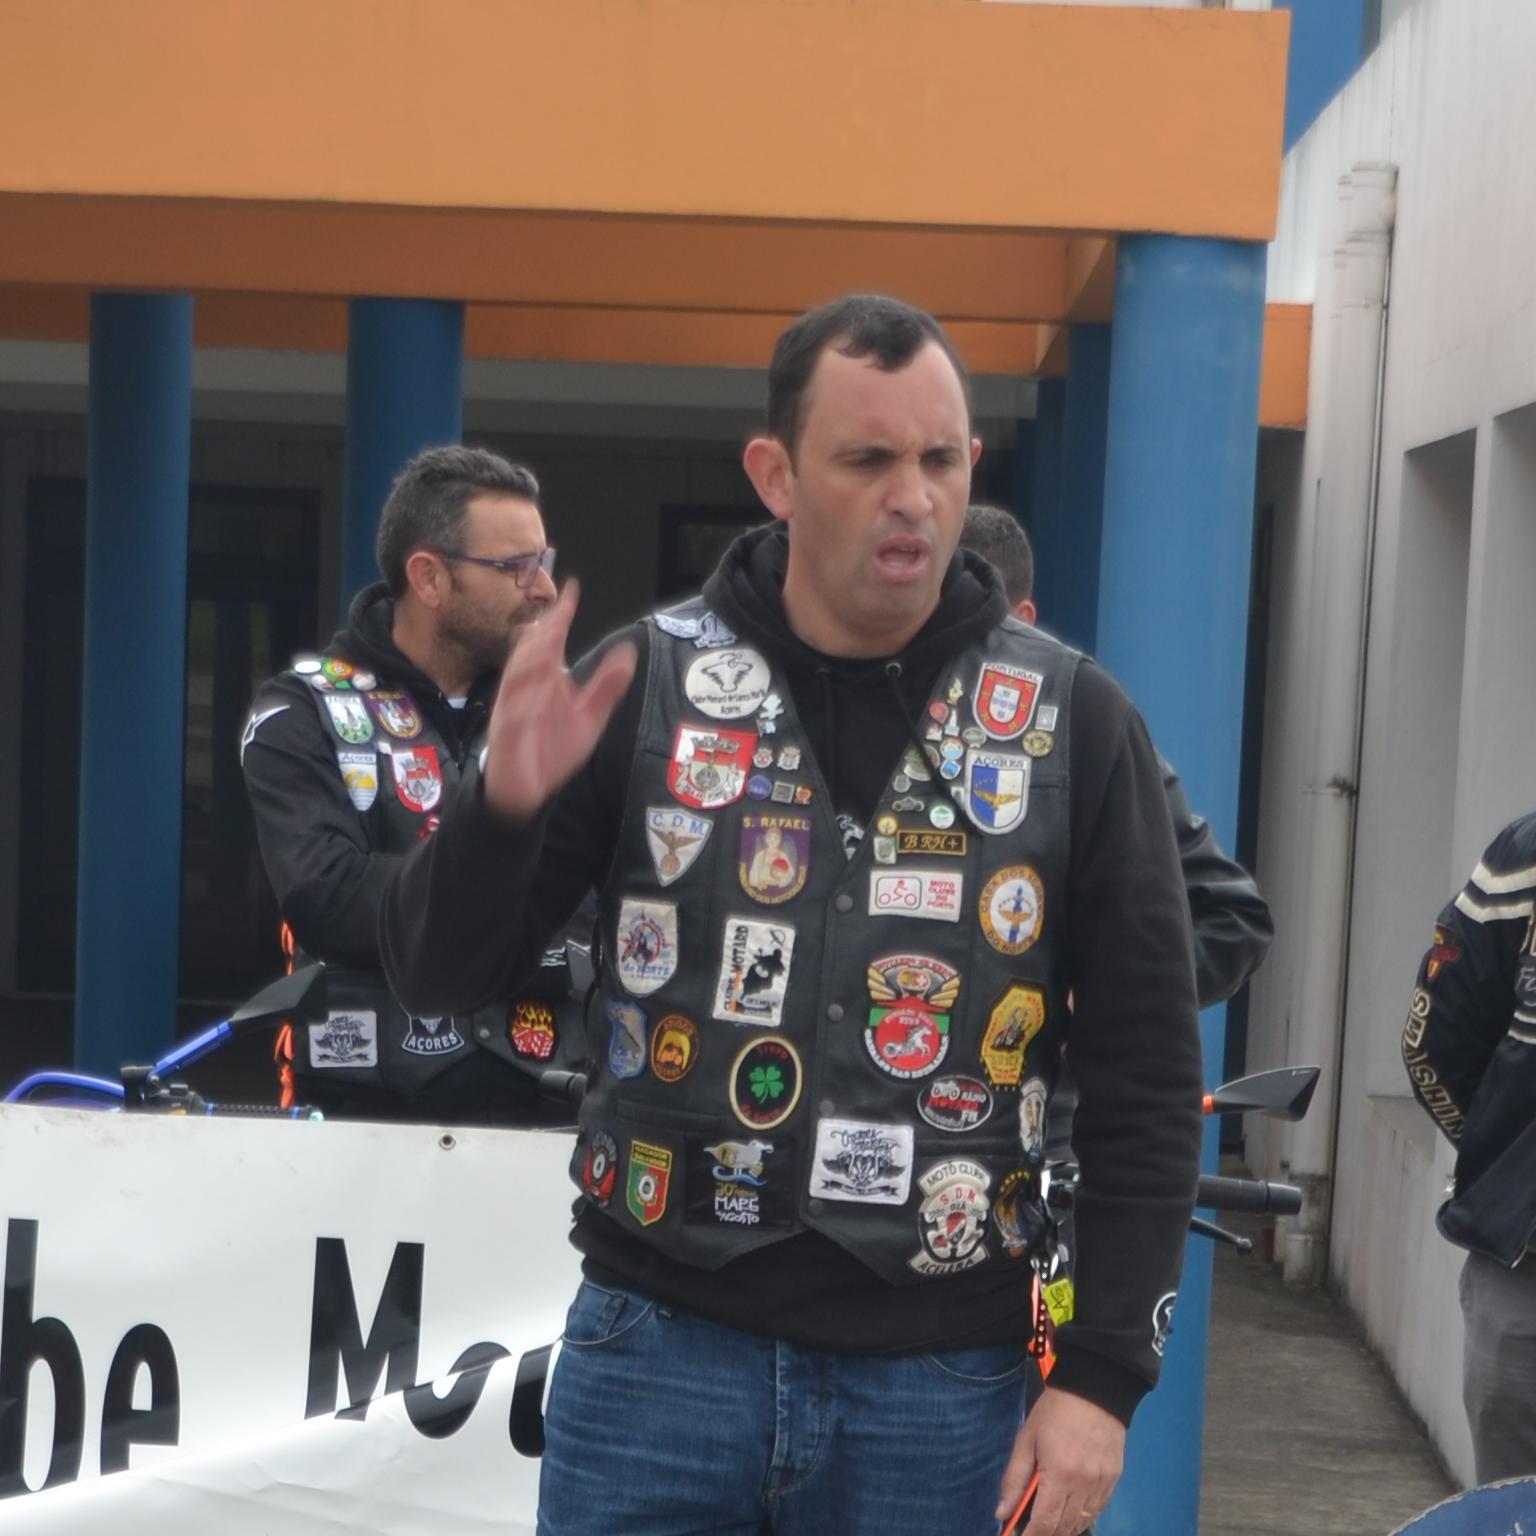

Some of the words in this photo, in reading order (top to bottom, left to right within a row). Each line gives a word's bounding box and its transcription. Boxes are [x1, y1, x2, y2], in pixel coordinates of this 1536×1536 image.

[984, 662, 1041, 683] PORTUGAL
[342, 752, 374, 764] Açores
[974, 754, 1026, 768] AÇORES
[760, 816, 811, 831] RAFAEL
[407, 1032, 460, 1050] AÇORES
